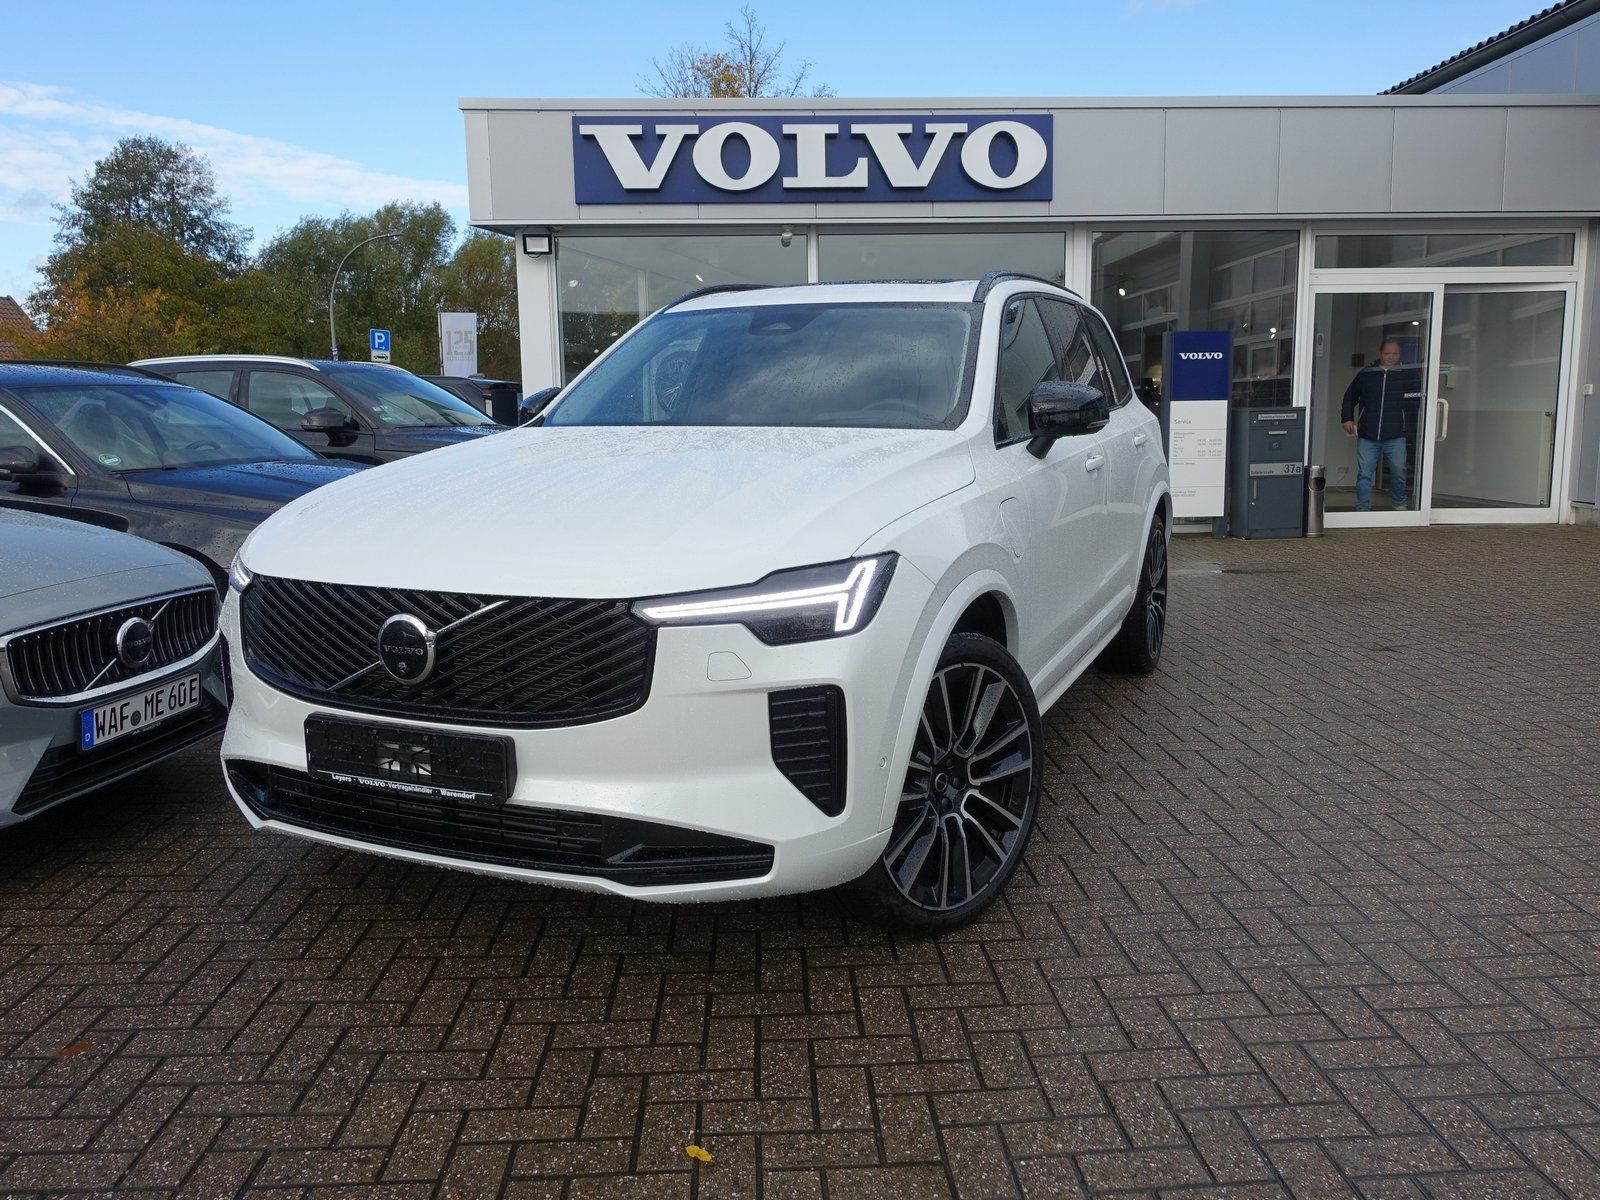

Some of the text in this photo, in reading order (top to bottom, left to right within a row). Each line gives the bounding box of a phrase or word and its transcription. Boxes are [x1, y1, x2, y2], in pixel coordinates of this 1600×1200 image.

[579, 120, 1047, 191] VOLVO
[374, 332, 386, 349] P
[445, 330, 474, 356] 125
[1179, 352, 1223, 360] VOLVO
[1284, 464, 1301, 474] 37a
[383, 644, 424, 656] VOLVO
[95, 702, 130, 739] WAF
[144, 689, 164, 721] ME
[331, 773, 352, 783] Leyers
[440, 789, 476, 800] Warendorf
